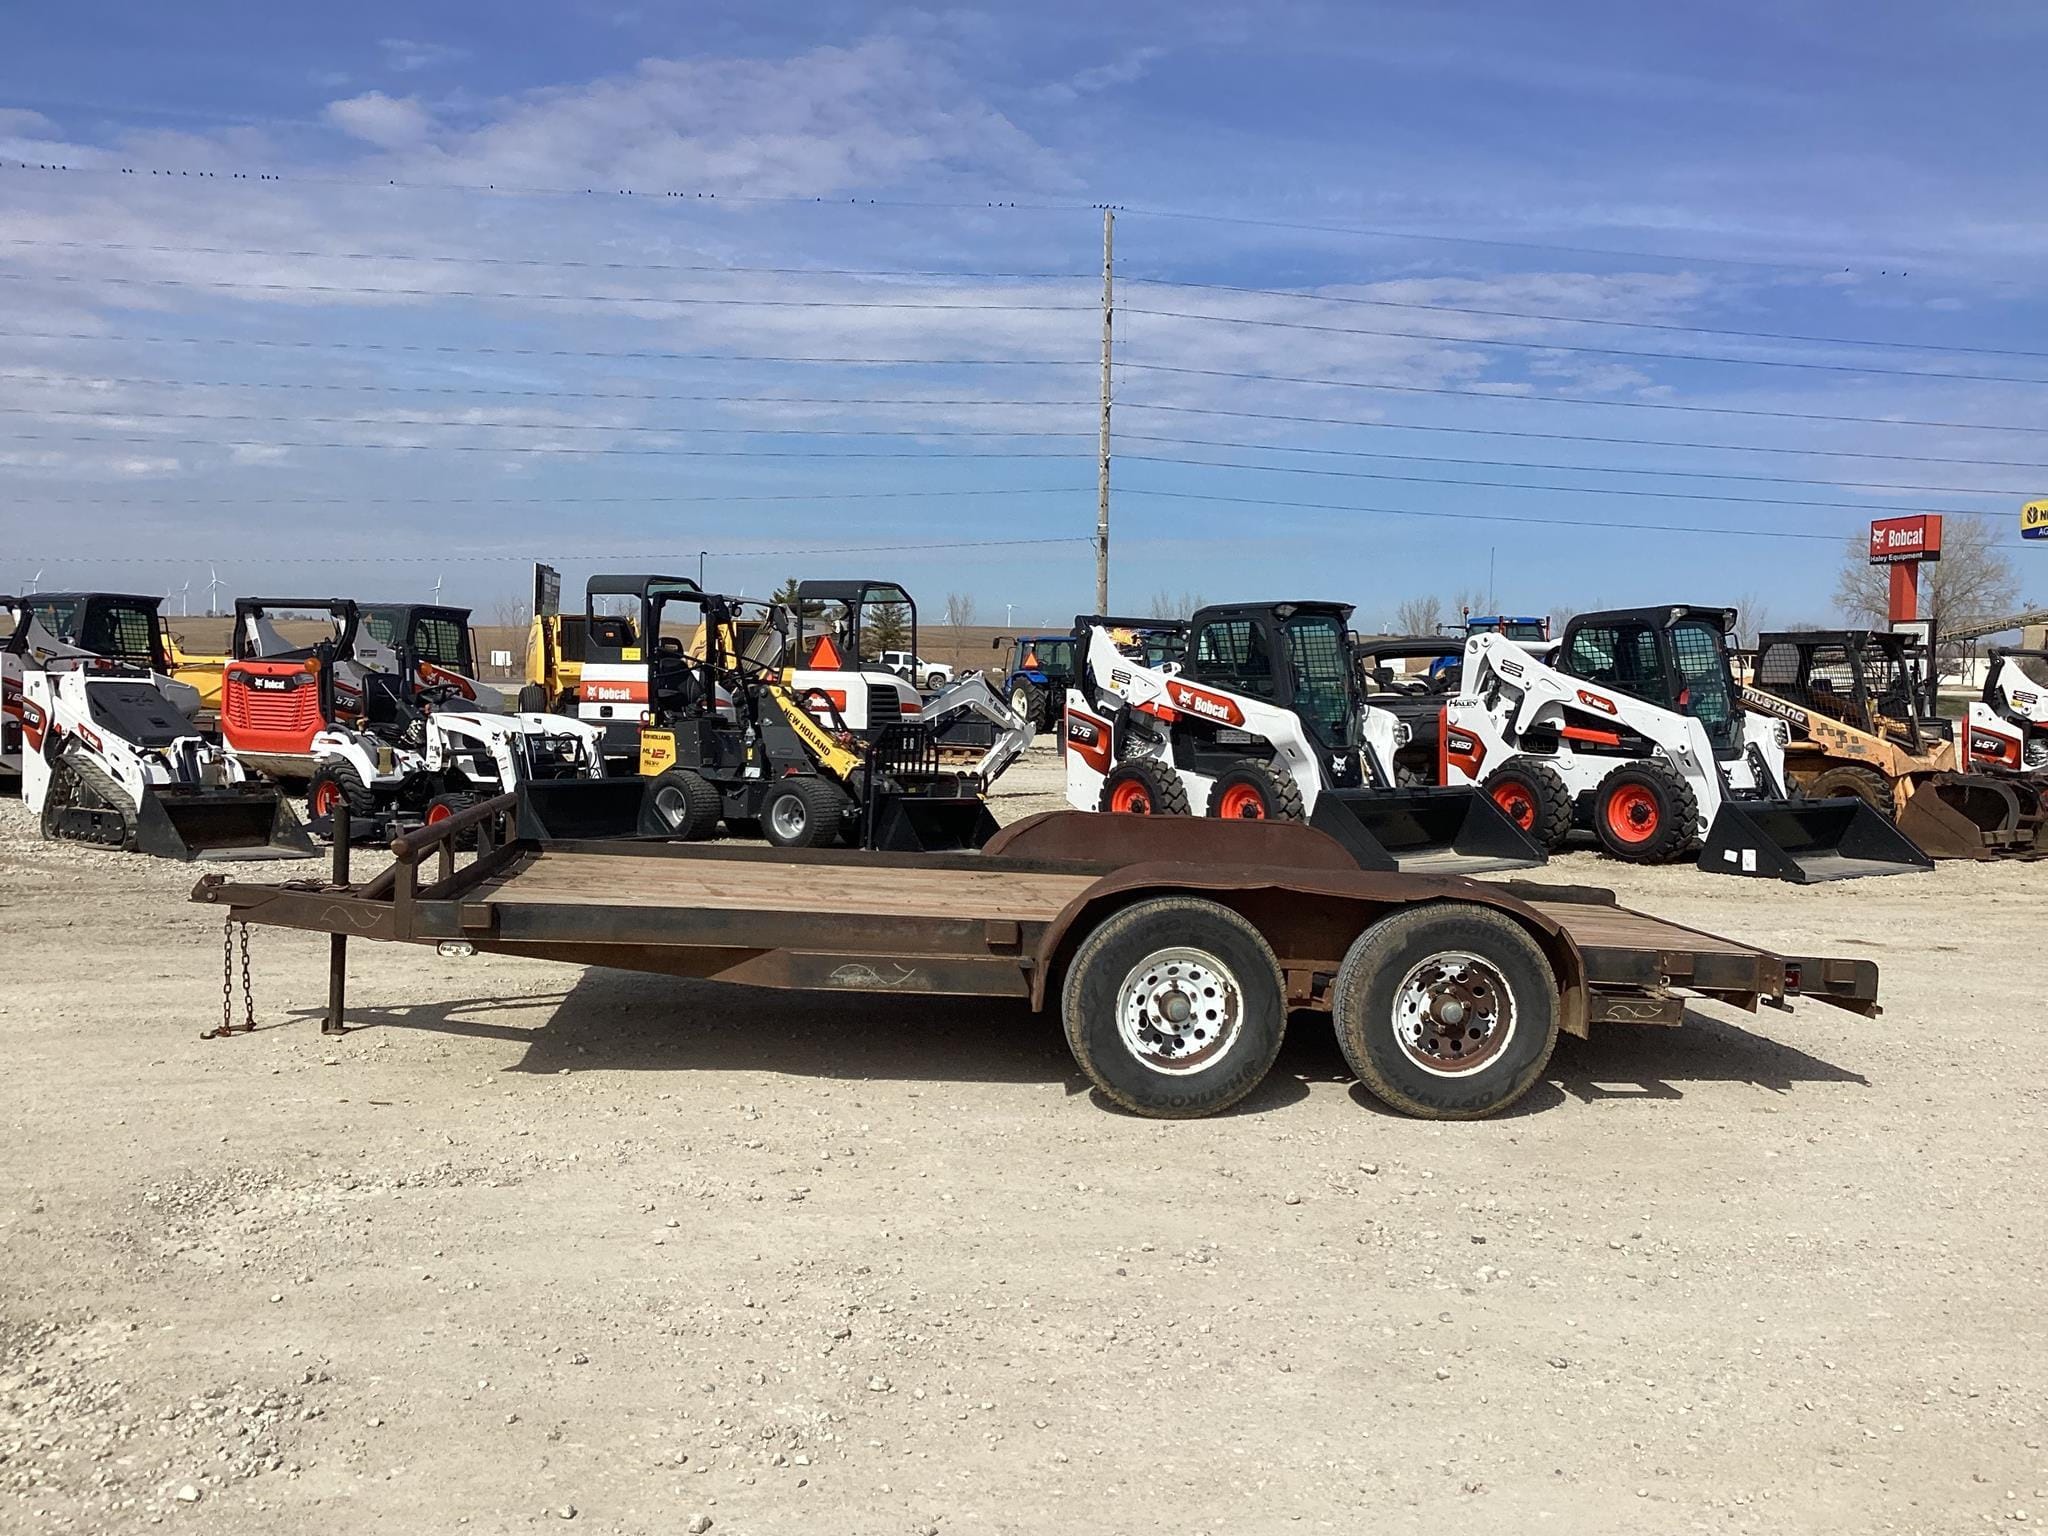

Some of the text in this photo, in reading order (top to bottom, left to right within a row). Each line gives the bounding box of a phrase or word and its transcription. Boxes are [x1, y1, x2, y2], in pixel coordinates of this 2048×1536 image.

[1888, 528, 1923, 547] Bobcat
[1871, 552, 1923, 563] Haley Equipment
[598, 687, 632, 700] Bobcat
[336, 696, 355, 707] S76
[1448, 699, 1478, 707] HALEY
[1742, 689, 1805, 722] MUSTANG
[1194, 697, 1229, 720] Bobcat
[783, 708, 831, 756] NEW HOLLAND
[1070, 725, 1092, 738] S76
[1974, 740, 1998, 750] S64
